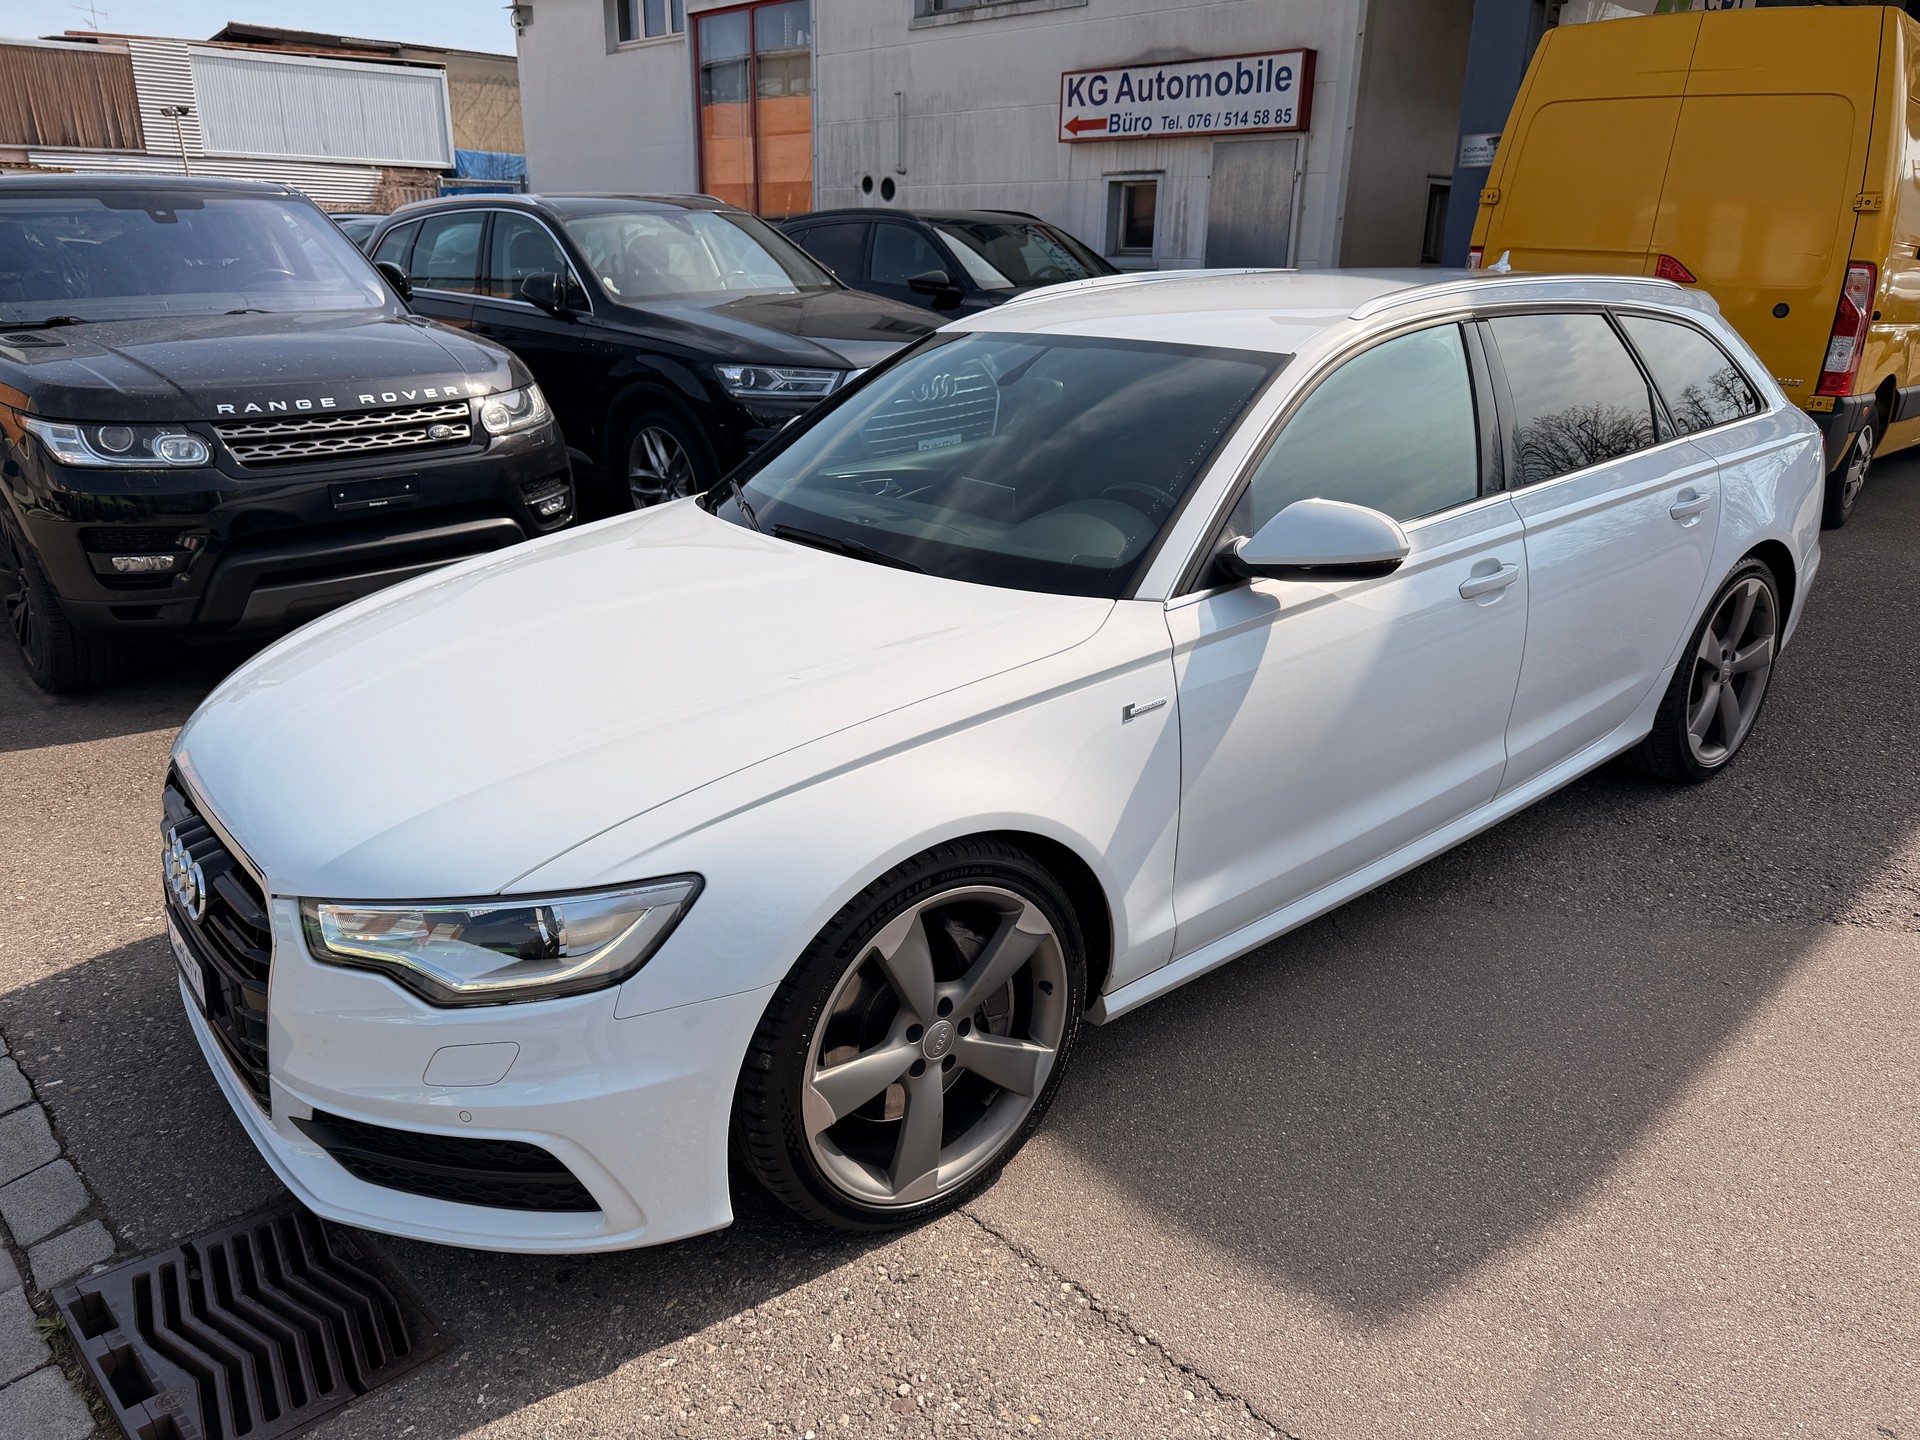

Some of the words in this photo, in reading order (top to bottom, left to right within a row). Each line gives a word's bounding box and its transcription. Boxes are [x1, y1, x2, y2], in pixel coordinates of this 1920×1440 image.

[1067, 75, 1108, 108] KG
[1114, 58, 1293, 104] Automobile
[1108, 113, 1153, 134] Büro
[1161, 115, 1183, 131] Tel.
[1187, 113, 1212, 129] 076
[1223, 111, 1249, 127] 514
[1252, 109, 1270, 125] 58
[1274, 107, 1292, 124] 85
[216, 397, 337, 415] RANGE
[358, 385, 461, 405] ROVER
[857, 877, 932, 938] MICHELIN
